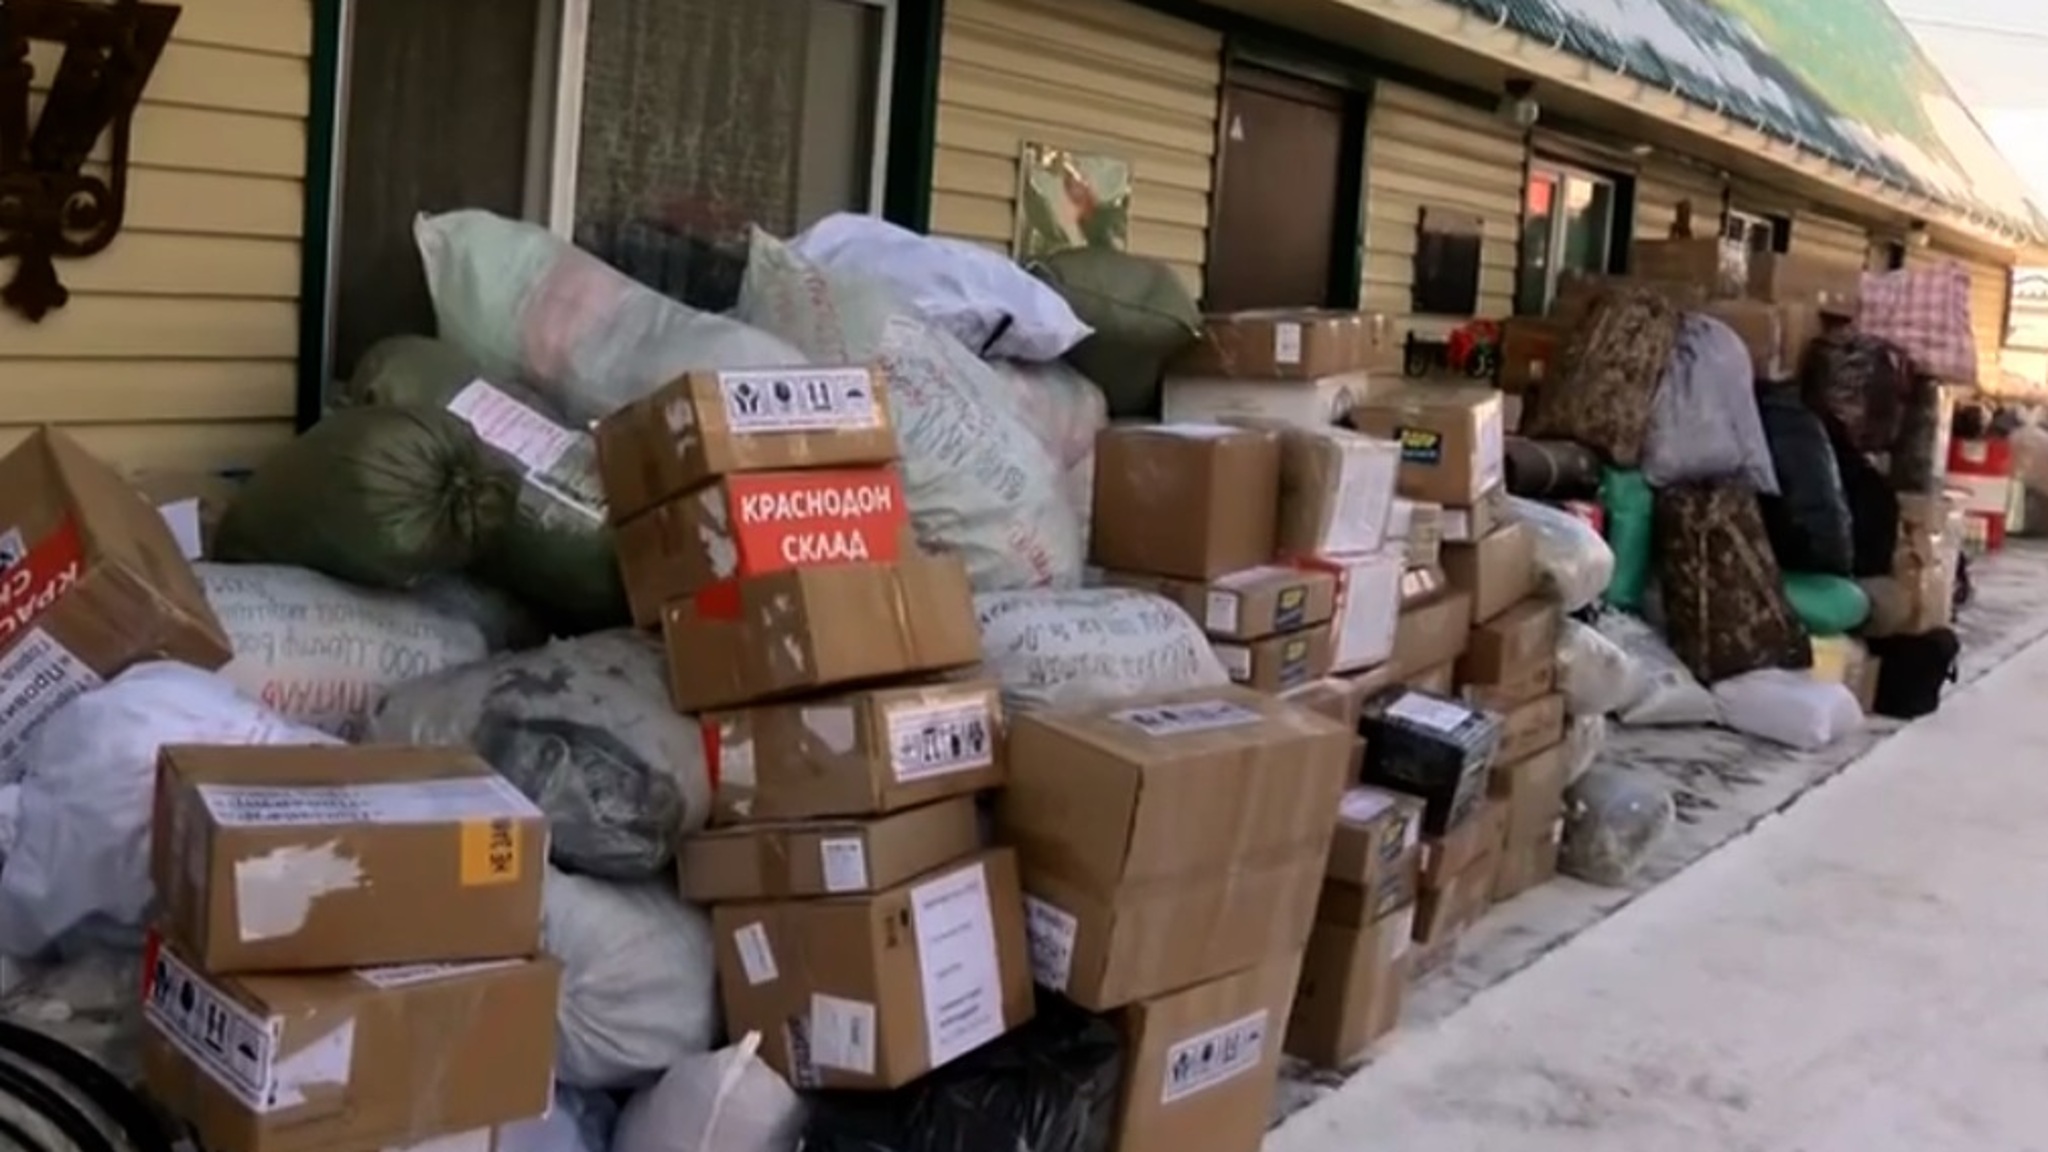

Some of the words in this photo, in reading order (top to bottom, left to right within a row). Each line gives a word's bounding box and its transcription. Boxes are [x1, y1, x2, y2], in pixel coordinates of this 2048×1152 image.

[740, 485, 893, 524] КРАСНОДОН
[781, 529, 869, 563] СКЛАД
[0, 569, 31, 605] СК
[0, 561, 77, 636] КРАС
